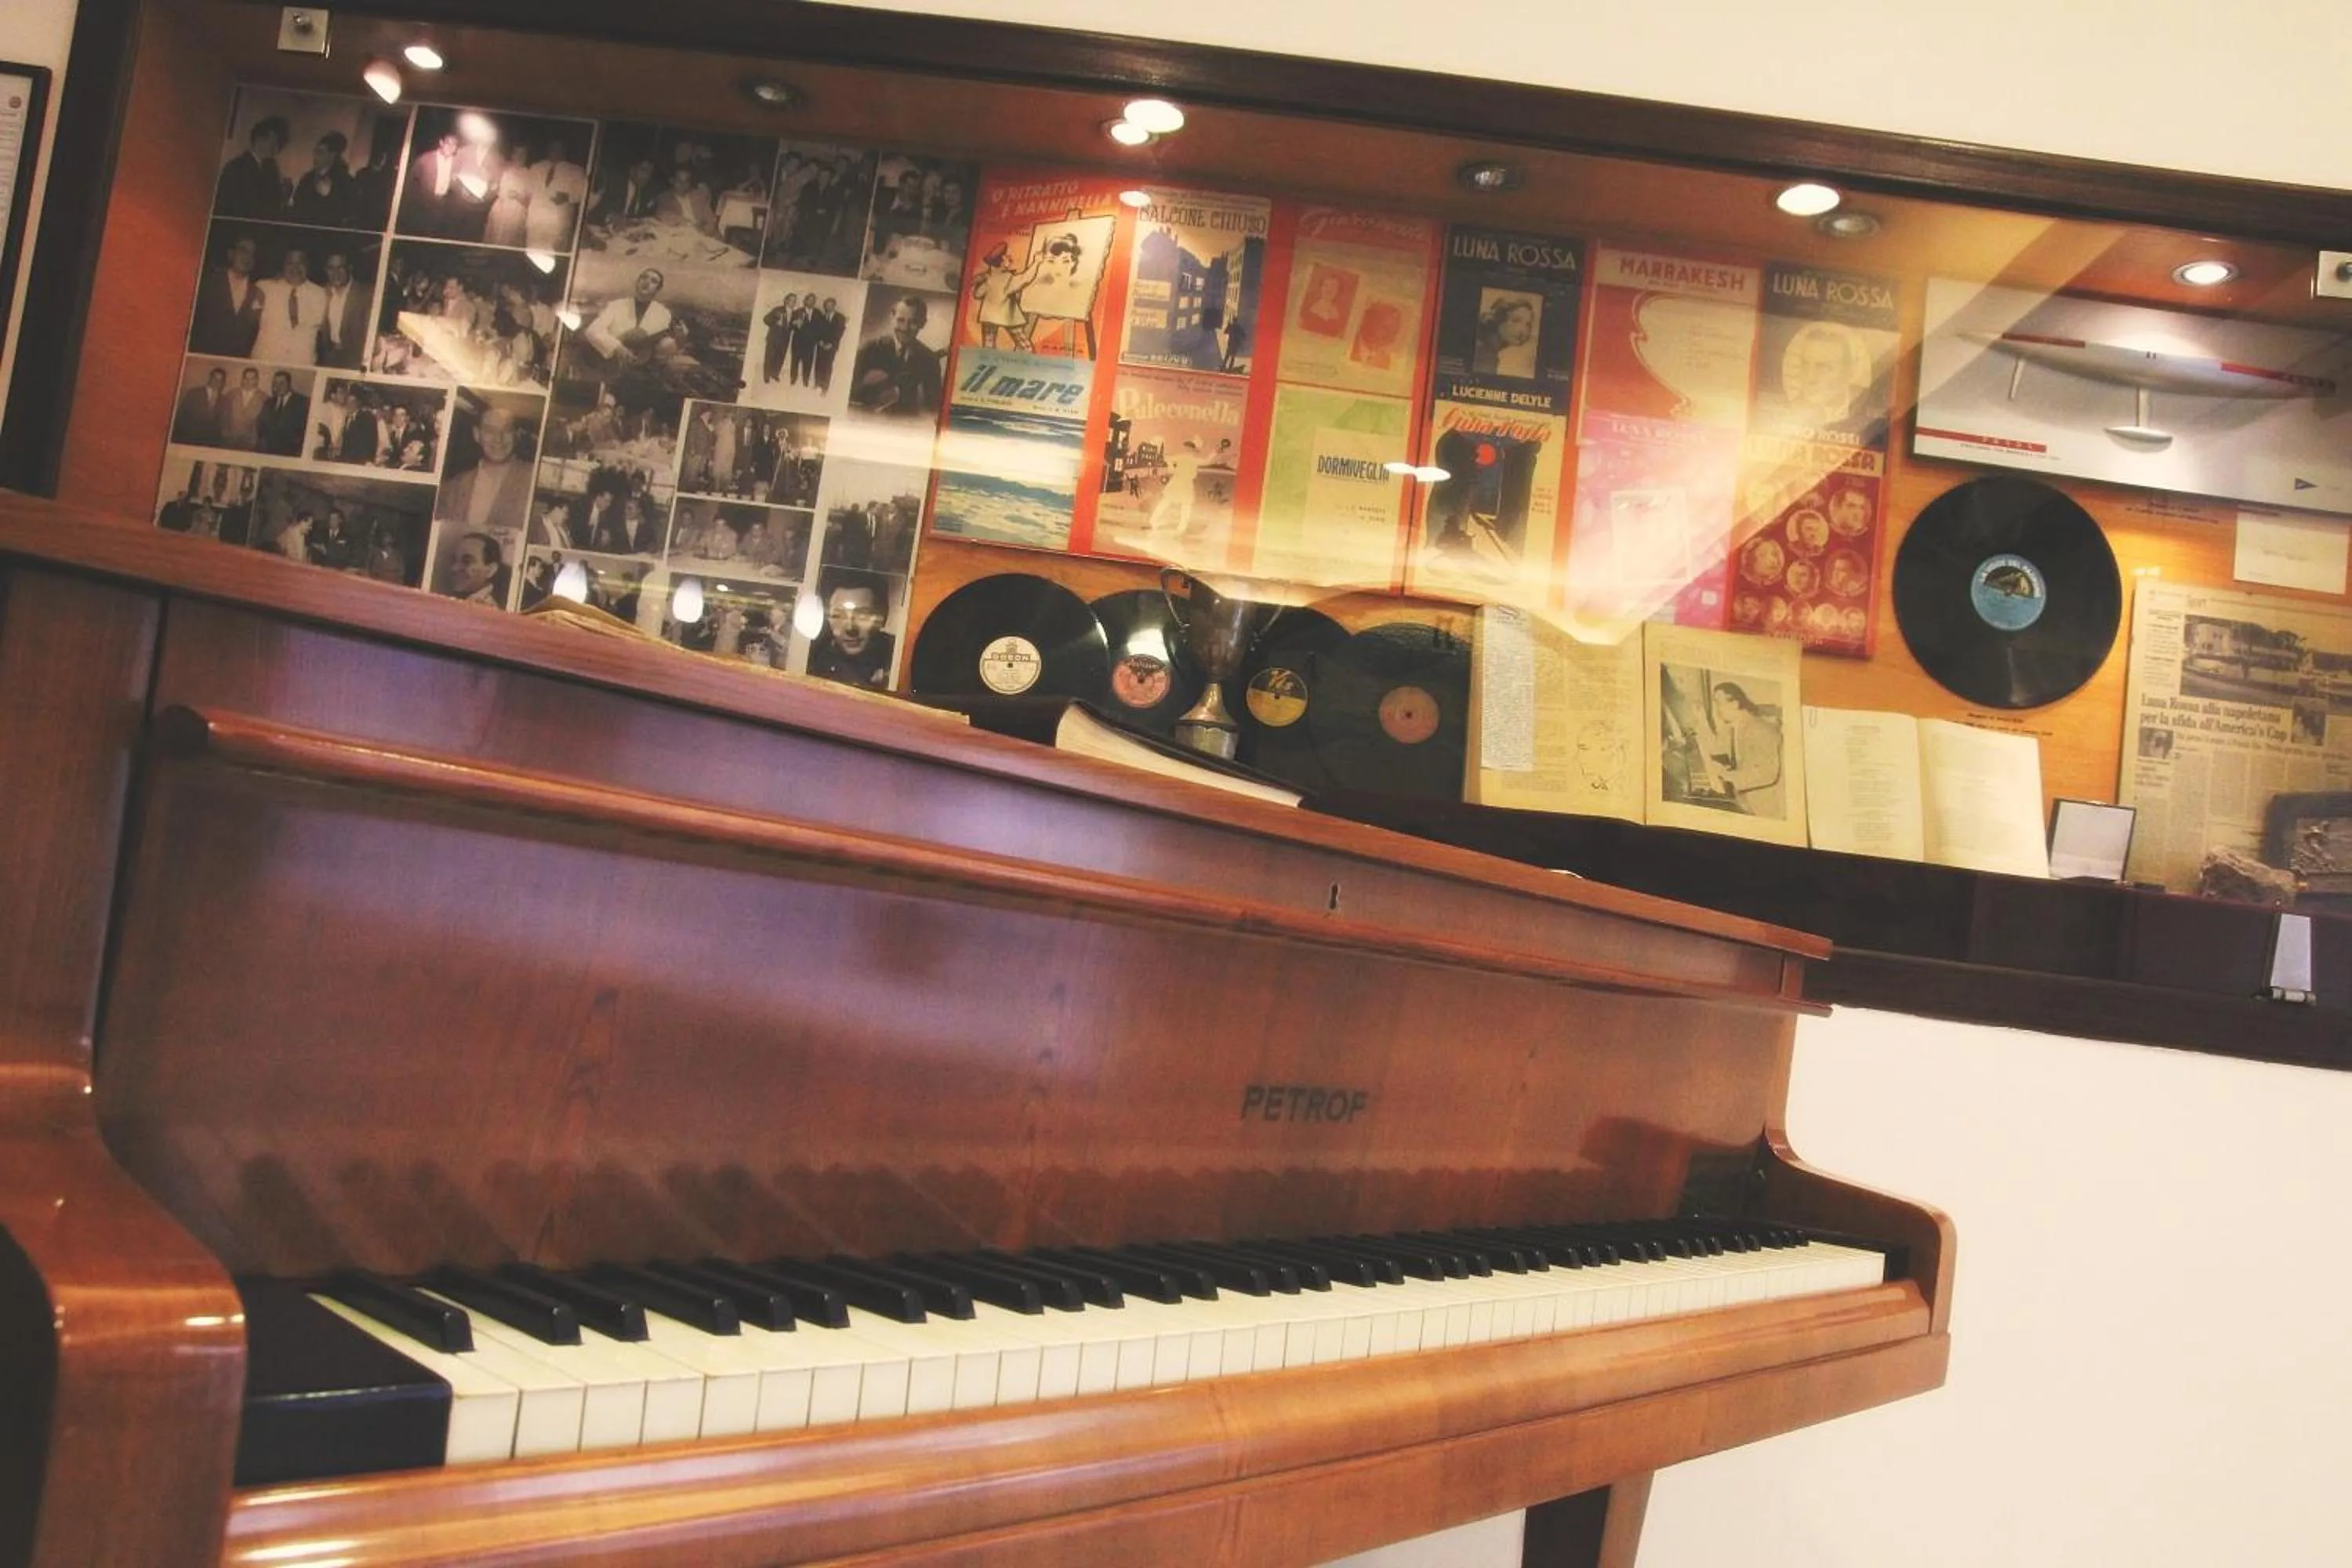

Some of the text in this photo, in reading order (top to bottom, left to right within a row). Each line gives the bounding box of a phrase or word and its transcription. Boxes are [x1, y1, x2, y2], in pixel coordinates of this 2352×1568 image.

[1139, 203, 1267, 235] BALCONE CHIUSO
[1454, 235, 1501, 263] LUNA
[1507, 241, 1577, 270] ROSSA
[1619, 256, 1745, 291] MARRAKESH
[1773, 272, 1895, 310] LUNA ROSSA
[960, 363, 998, 393] il
[989, 375, 1085, 406] mare
[1452, 384, 1552, 408] LUCIENNE DELYLE
[1317, 455, 1390, 482] DORMIVEGLIA
[2140, 713, 2158, 724] per
[2159, 712, 2169, 725] la
[2141, 693, 2168, 708] Luna
[2169, 697, 2199, 713] Rossa
[2201, 702, 2221, 716] alla
[1240, 1086, 1367, 1122] PETROF
